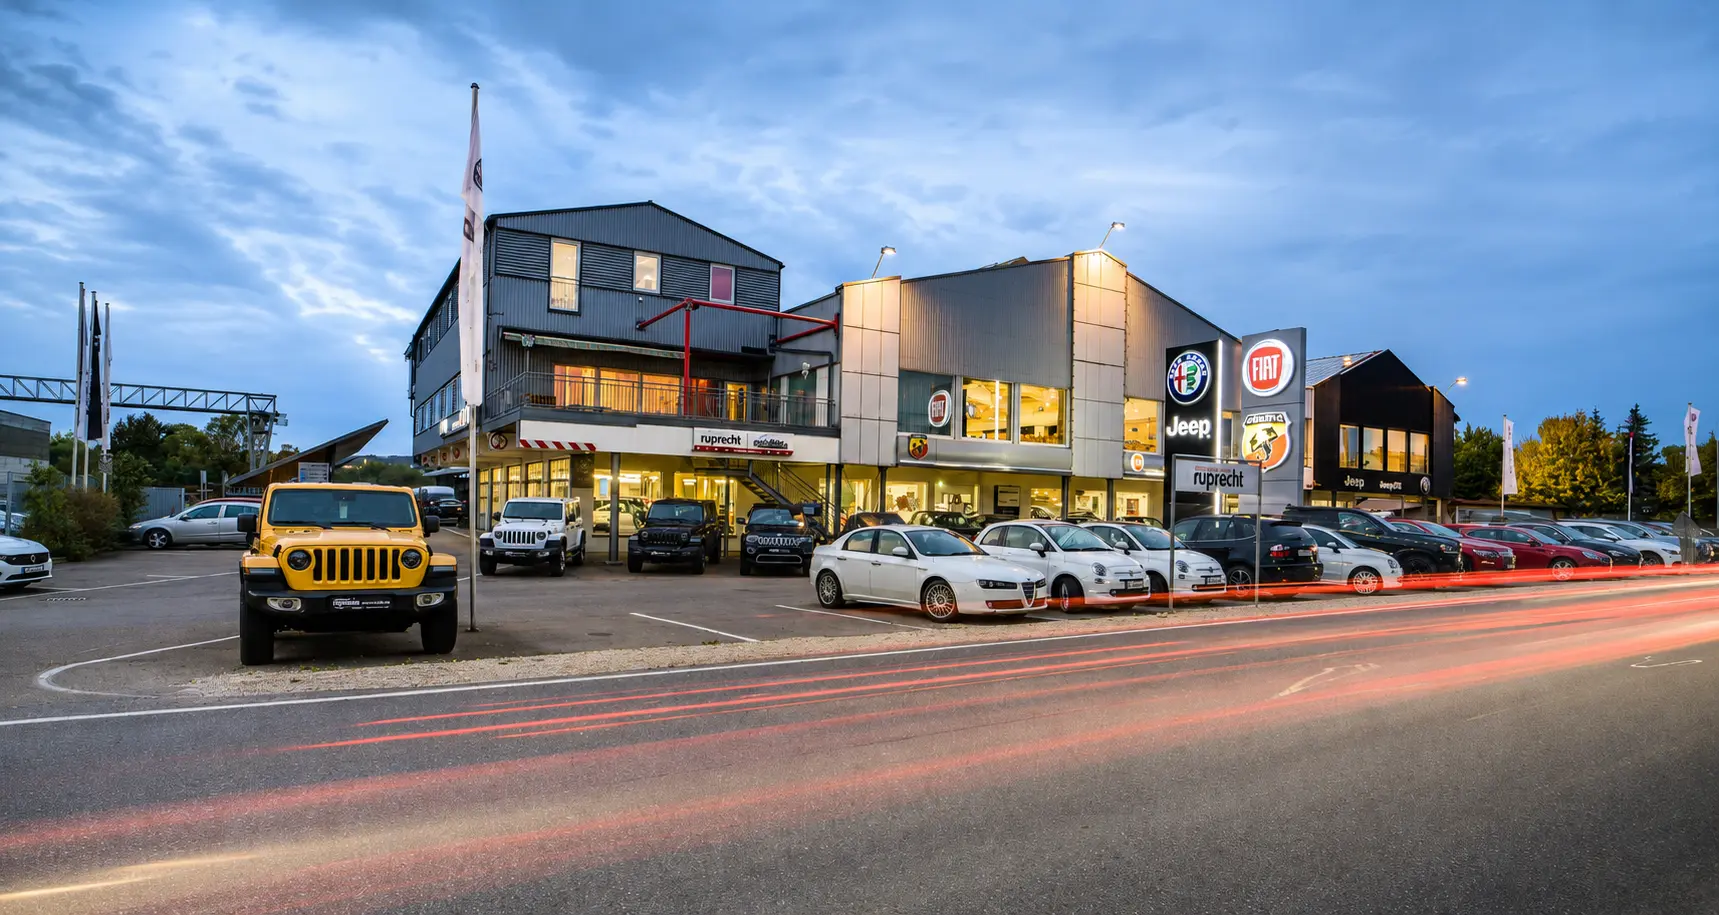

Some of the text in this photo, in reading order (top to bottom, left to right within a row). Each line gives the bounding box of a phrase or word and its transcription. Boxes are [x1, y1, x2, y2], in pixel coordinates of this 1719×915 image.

[1252, 354, 1280, 381] FIAT
[1166, 416, 1211, 439] Jeep
[700, 434, 741, 445] ruprecht
[1193, 469, 1244, 491] ruprecht
